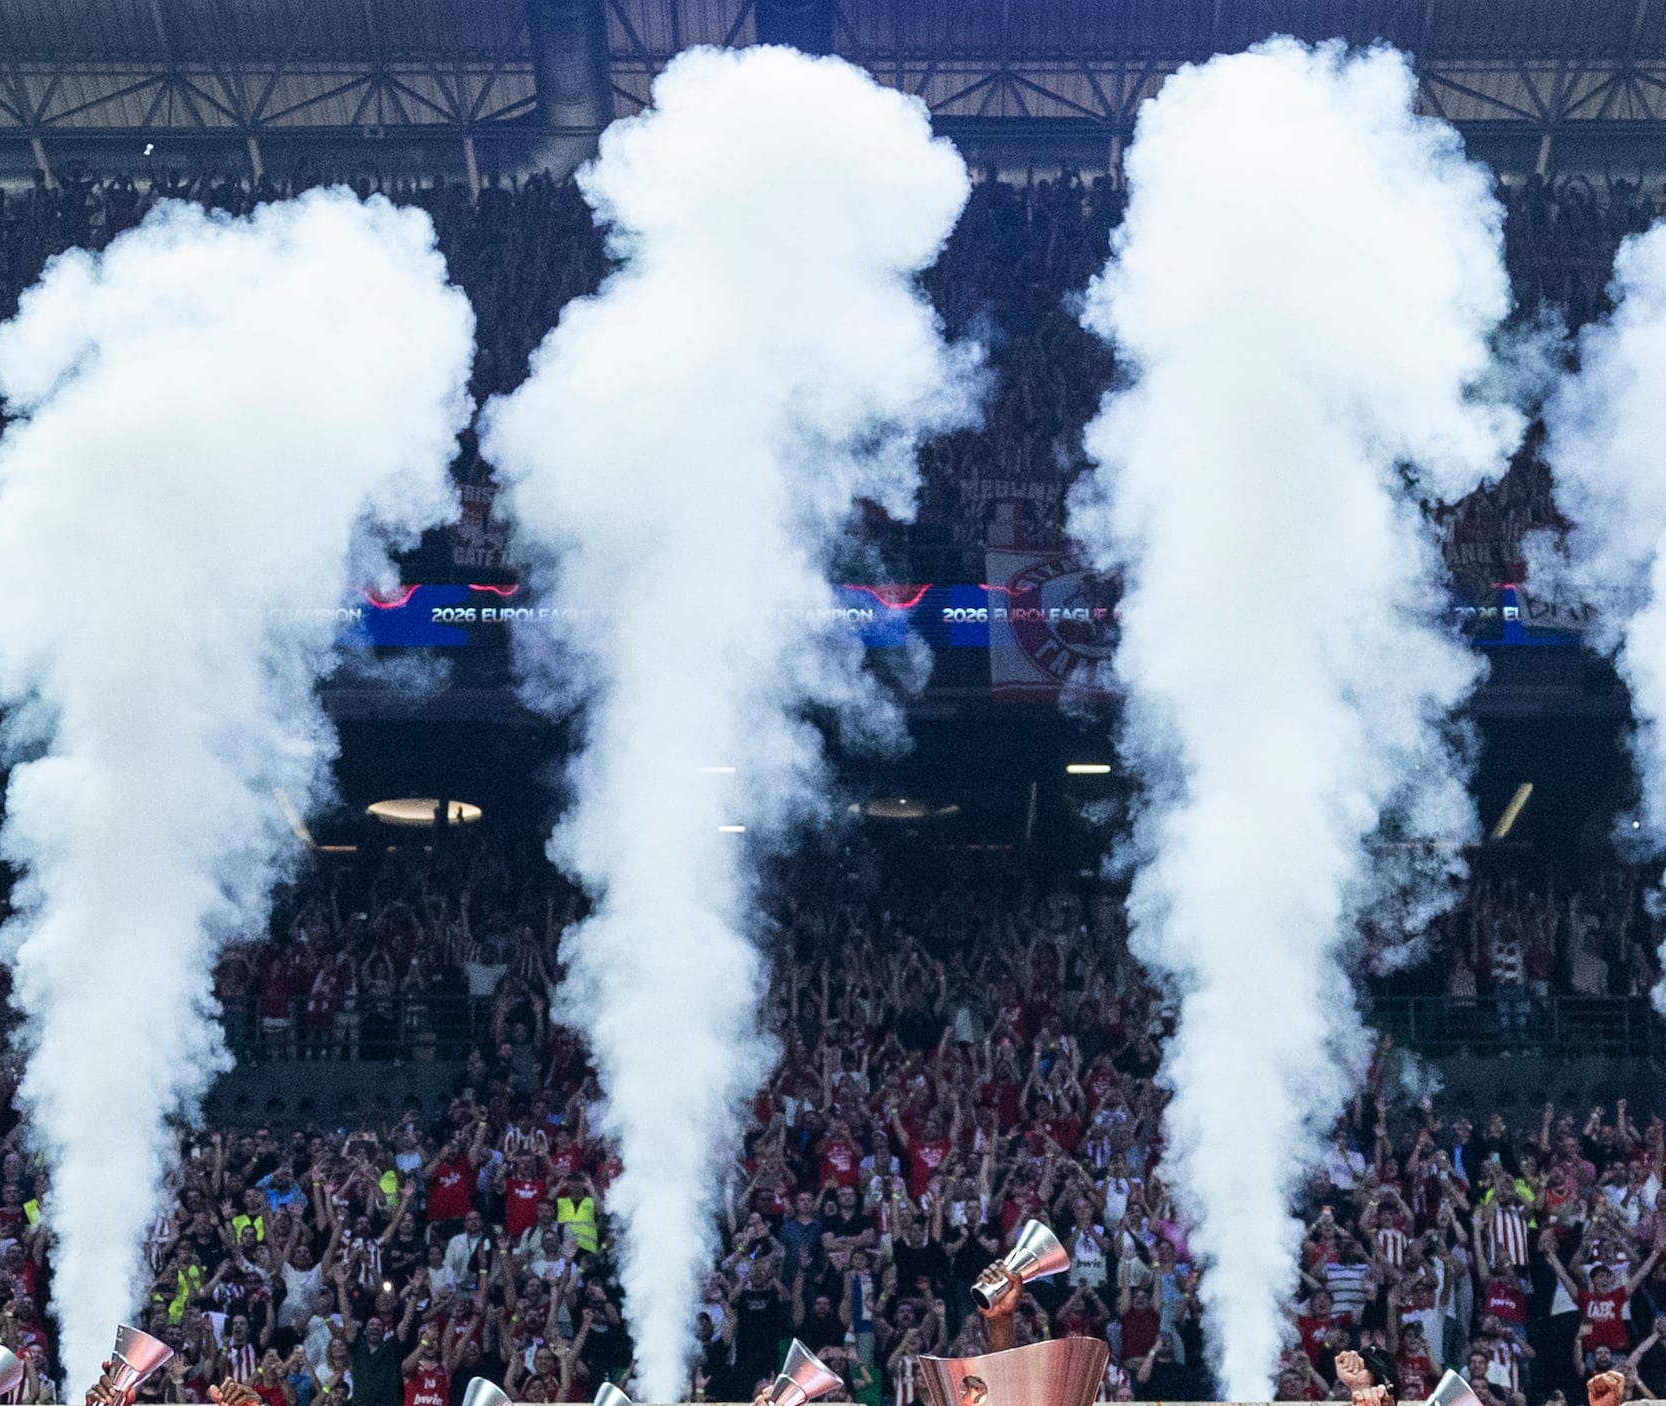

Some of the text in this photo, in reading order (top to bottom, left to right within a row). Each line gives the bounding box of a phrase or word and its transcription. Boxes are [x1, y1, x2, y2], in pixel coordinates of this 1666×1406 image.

[431, 608, 476, 623] 2026
[943, 607, 1108, 623] 2026 EUROLEAGUE
[413, 1393, 443, 1406] bwin
